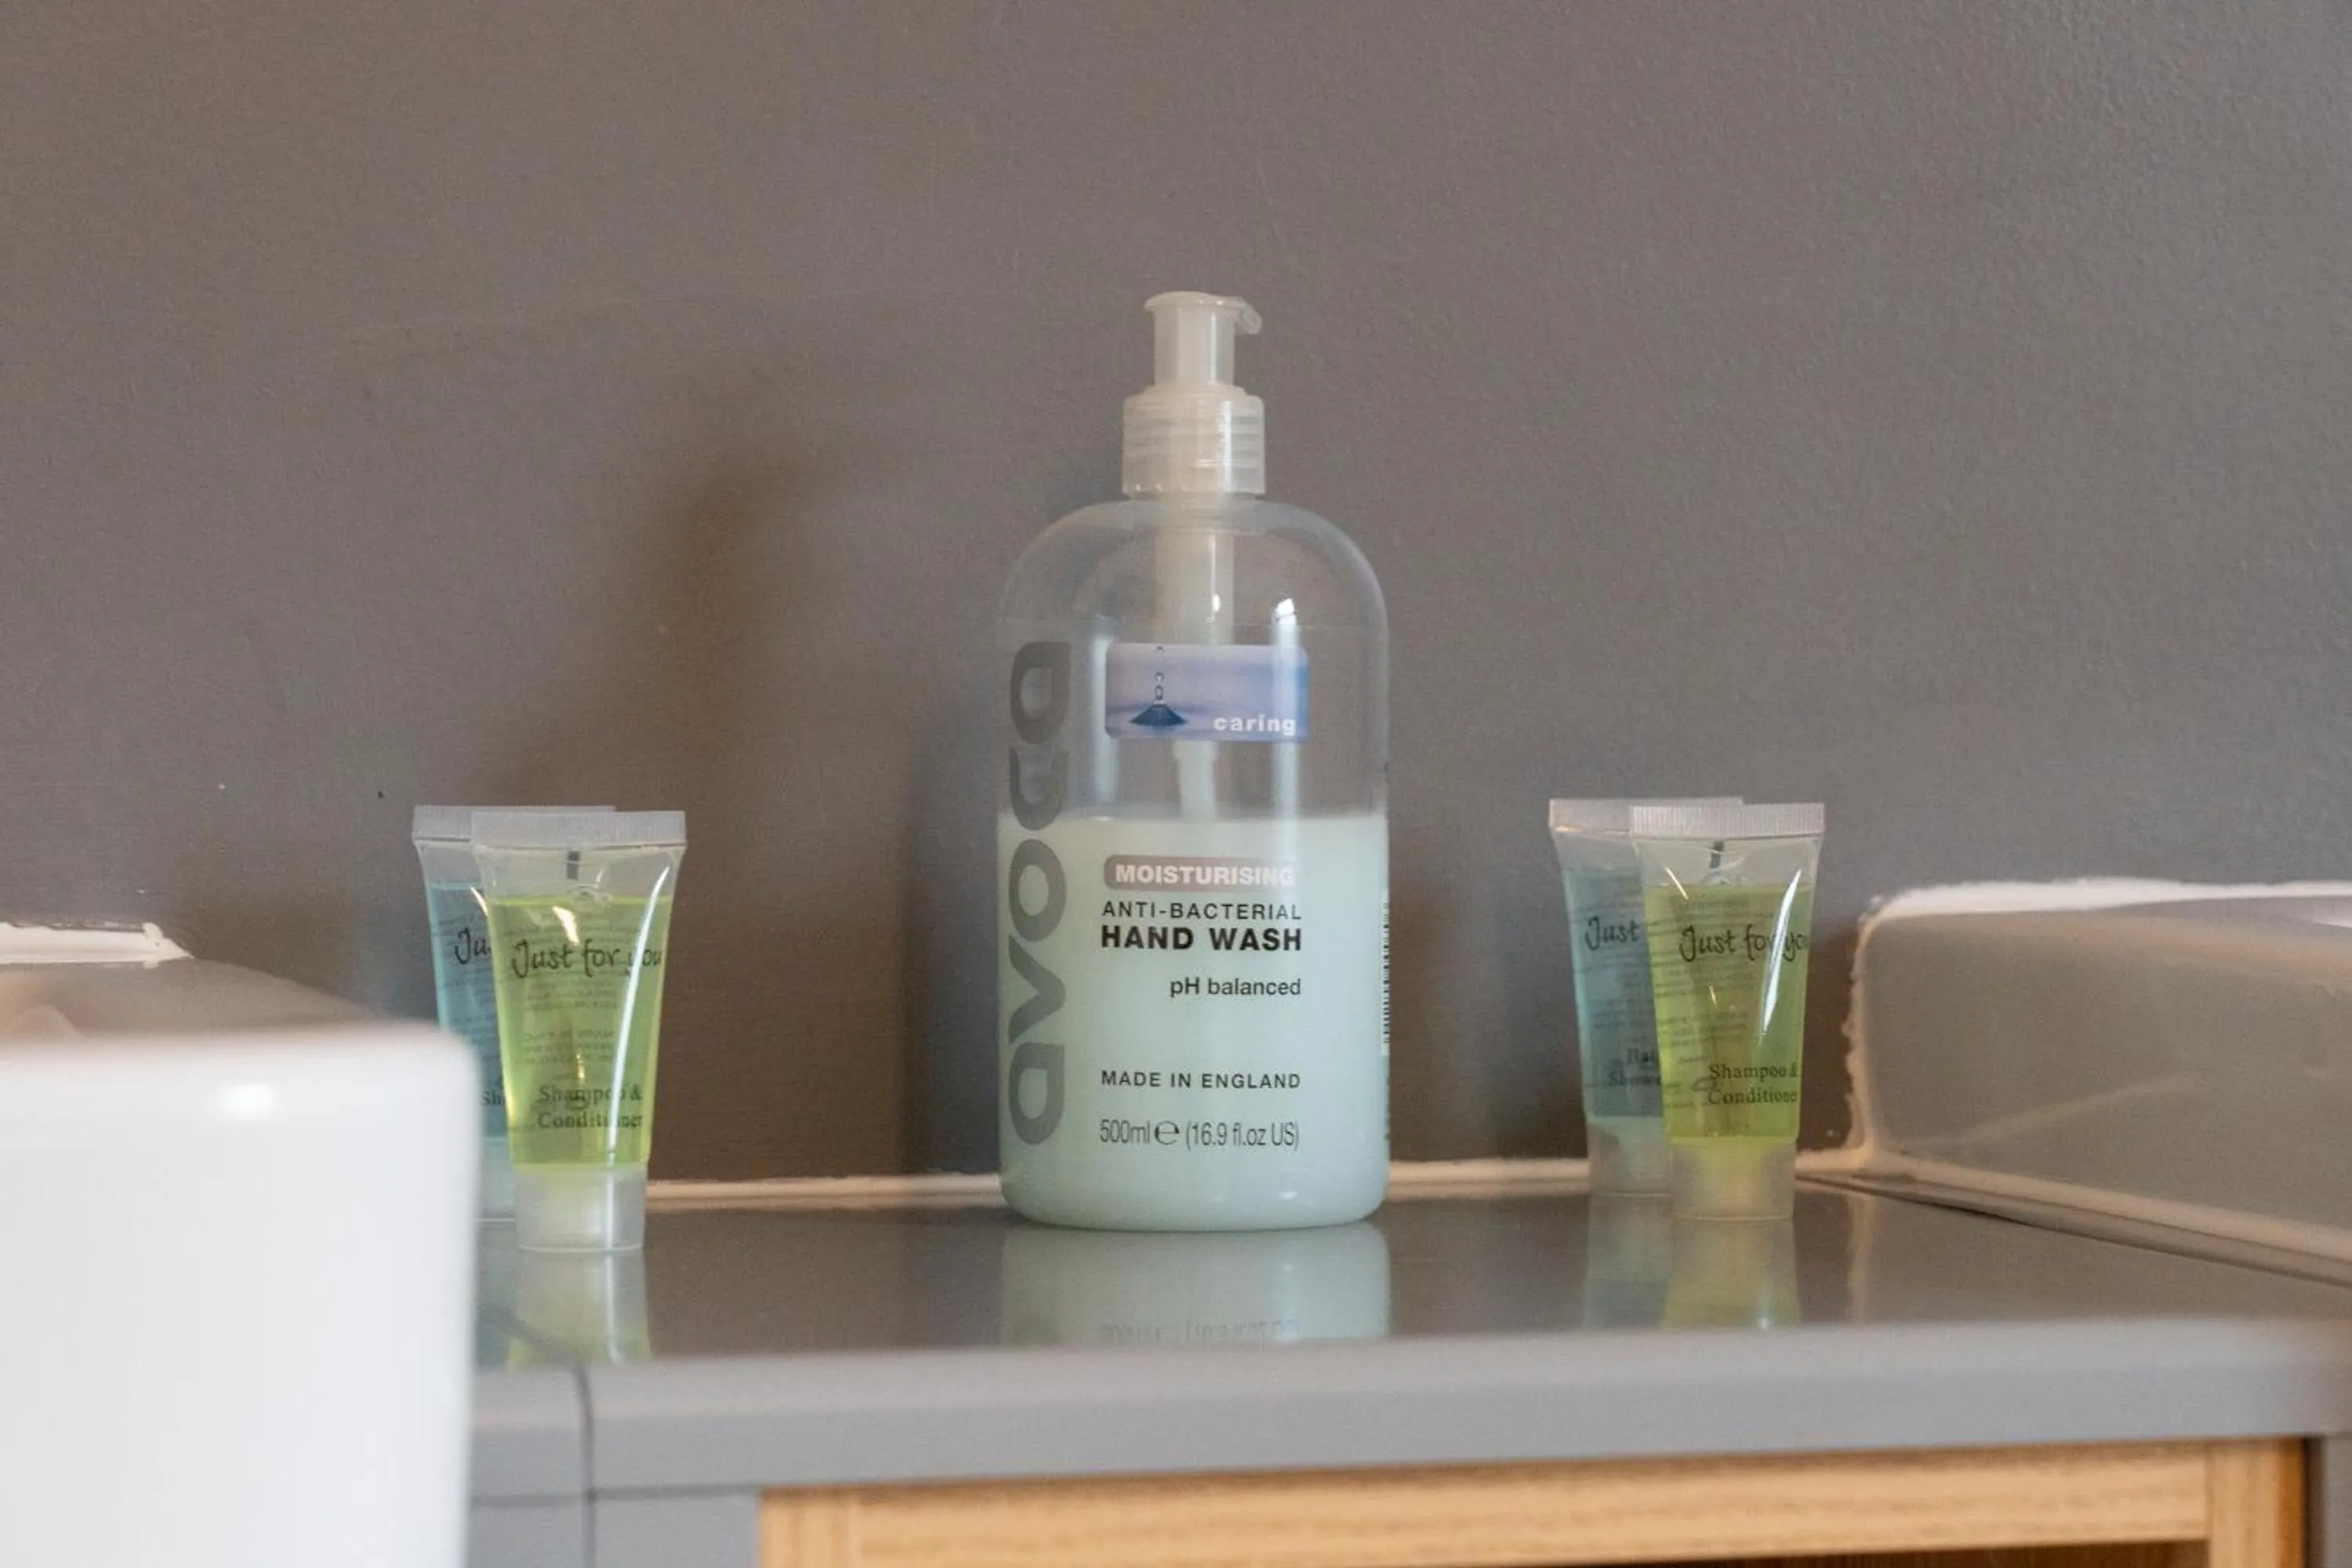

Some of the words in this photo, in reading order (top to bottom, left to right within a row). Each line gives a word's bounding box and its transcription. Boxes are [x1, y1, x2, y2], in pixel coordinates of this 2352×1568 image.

[1214, 714, 1296, 736] caring
[1116, 864, 1295, 885] MOISTURISING
[1008, 641, 1072, 1145] avoca
[1102, 902, 1302, 920] ANTI-BACTERIAL
[1101, 925, 1194, 950] HAND
[1208, 927, 1302, 952] WASH
[1584, 916, 1641, 952] Just
[1679, 925, 1737, 962] Just
[1782, 931, 1806, 963] yo
[455, 928, 492, 964] Ju
[512, 939, 573, 978] Just
[583, 938, 621, 978] for
[1171, 977, 1200, 998] pH
[1207, 978, 1301, 996] balanced
[1101, 1071, 1161, 1087] MADE
[1171, 1073, 1192, 1088] IN
[1201, 1073, 1301, 1089] ENGLAND
[1708, 1063, 1788, 1083] Shampoo
[630, 1084, 644, 1102] &
[537, 1111, 643, 1130] Conditiner
[1099, 1120, 1150, 1145] 500ml
[1185, 1122, 1229, 1150] (16.9
[1232, 1122, 1267, 1147] fl.oz
[1271, 1122, 1300, 1150] US)
